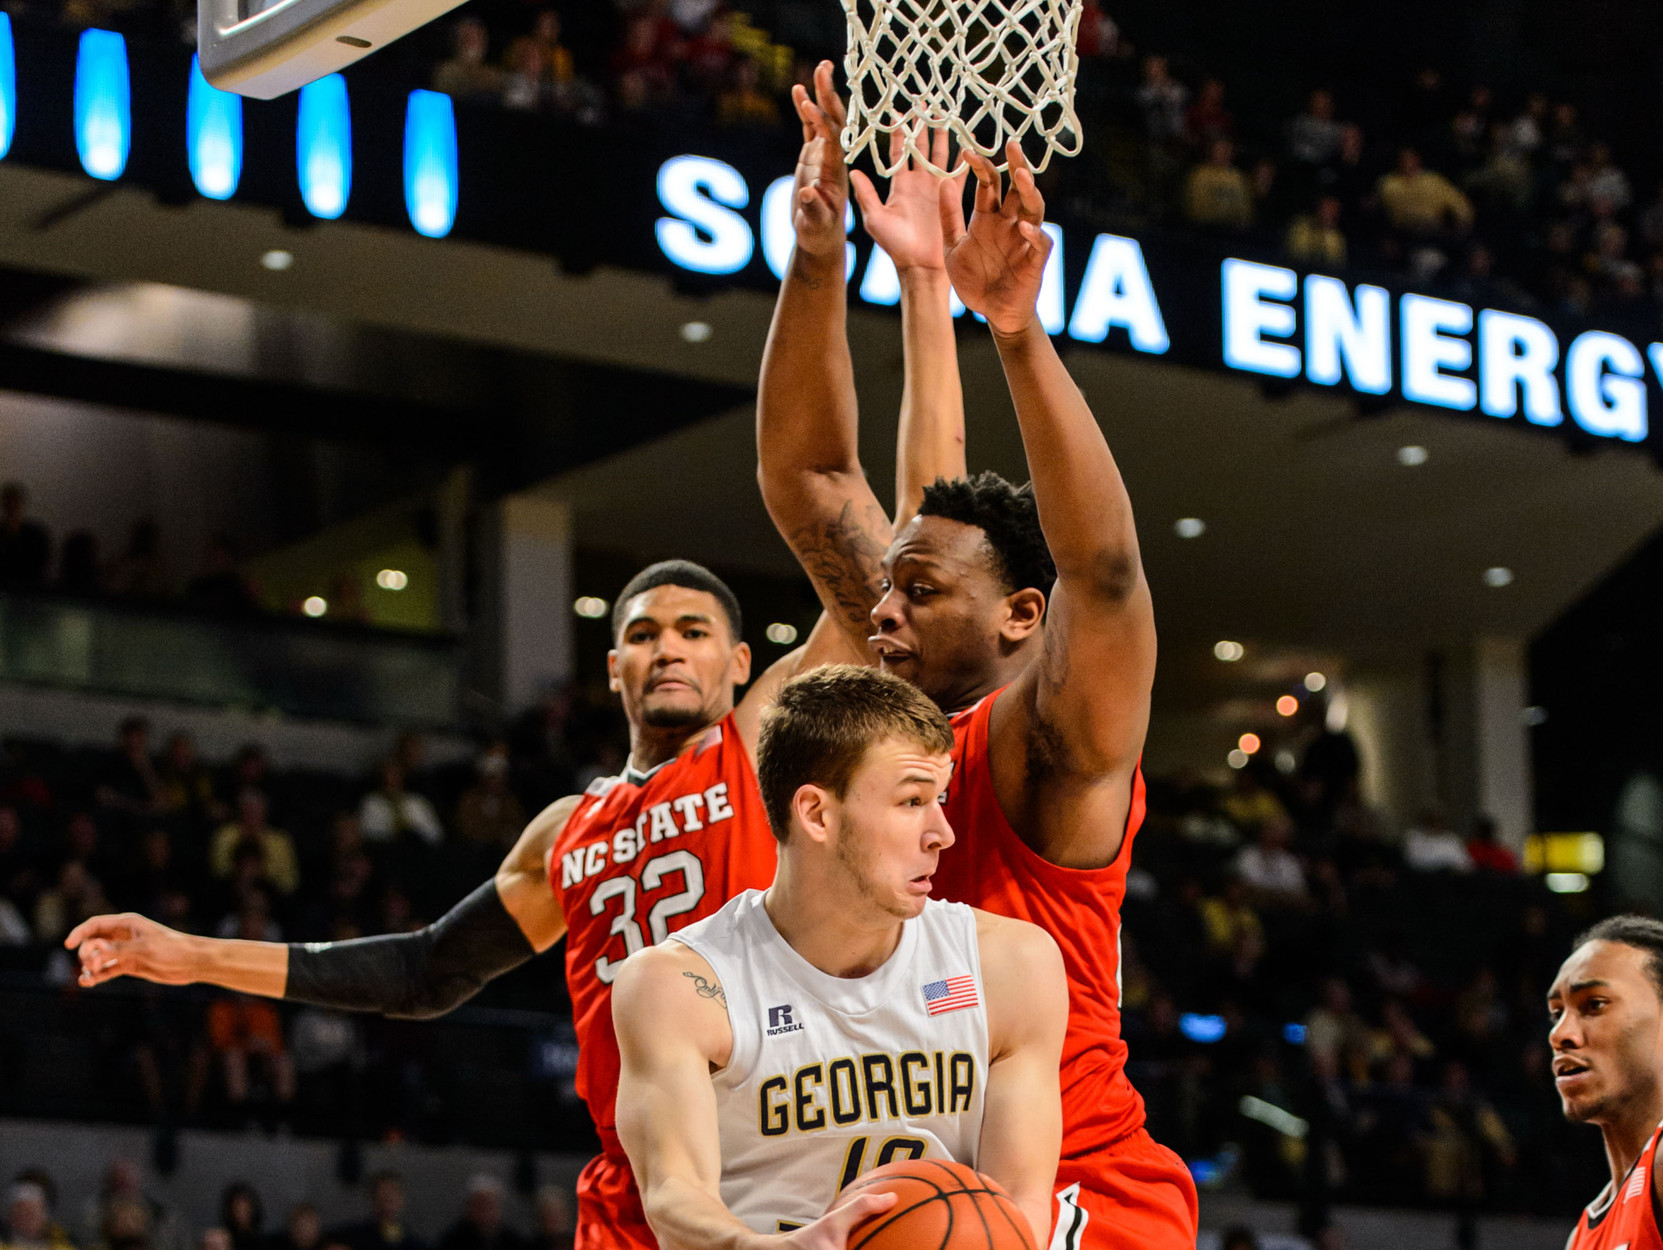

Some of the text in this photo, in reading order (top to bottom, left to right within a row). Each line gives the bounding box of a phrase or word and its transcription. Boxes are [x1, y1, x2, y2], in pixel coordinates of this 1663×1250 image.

[561, 841, 609, 890] NC
[589, 849, 706, 984] 32
[766, 1022, 805, 1037] RUSSELL
[768, 1004, 793, 1028] R
[758, 1050, 976, 1137] GEORGIA
